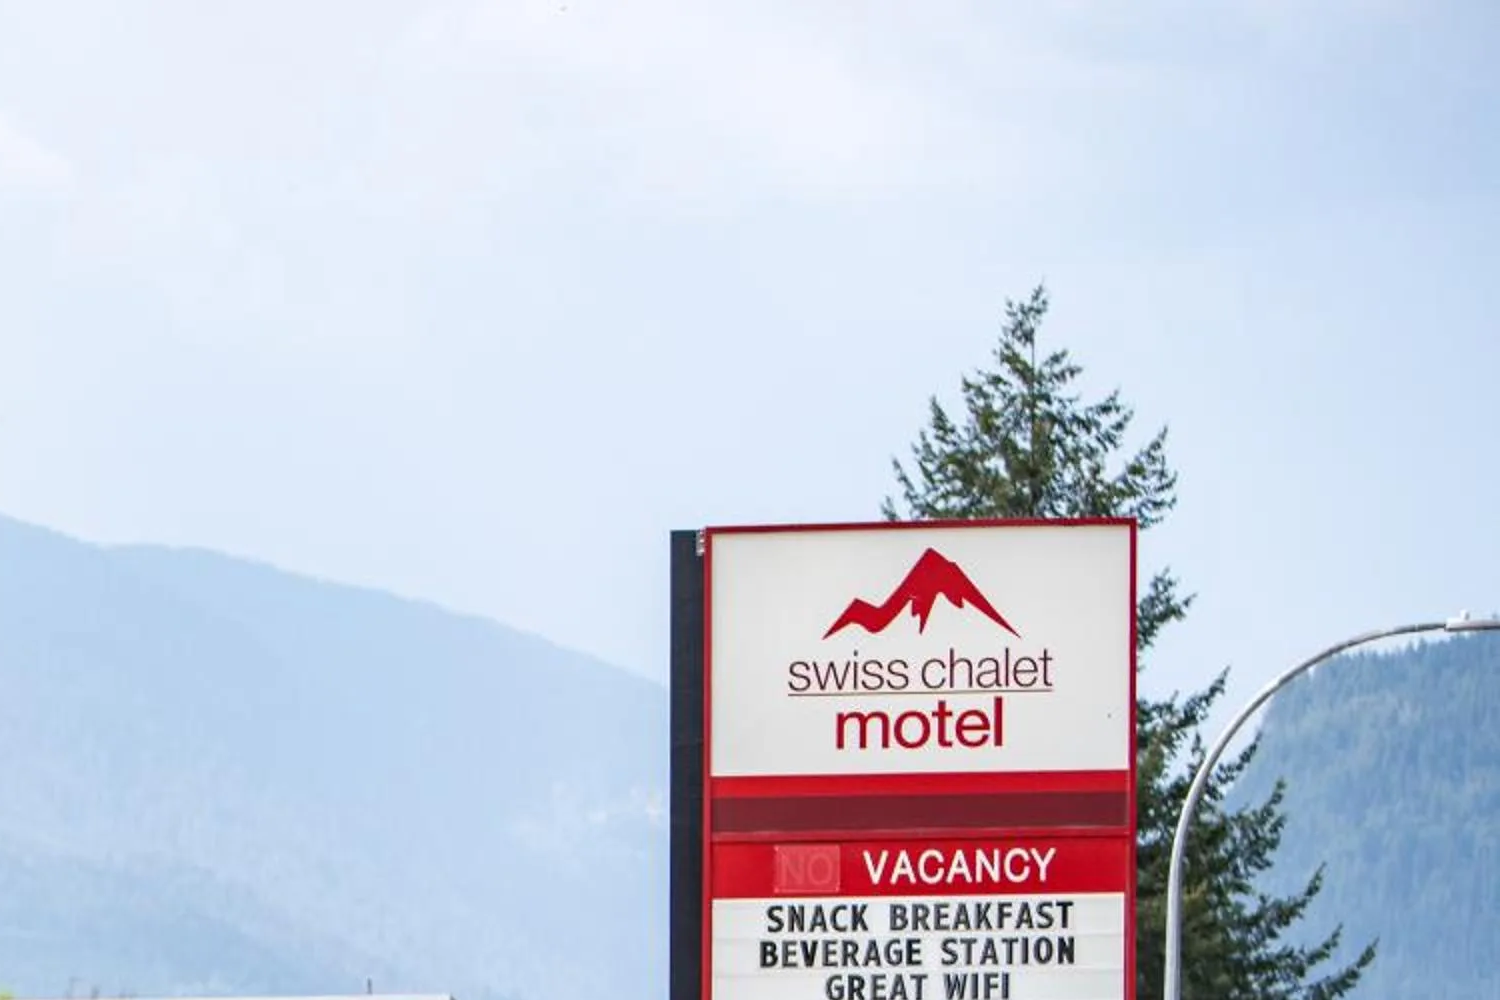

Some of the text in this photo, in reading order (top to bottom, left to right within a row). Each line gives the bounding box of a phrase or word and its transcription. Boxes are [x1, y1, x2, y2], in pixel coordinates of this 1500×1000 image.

[787, 647, 1053, 691] swiss chalet
[836, 696, 1004, 750] motel
[781, 848, 1056, 886] NO VACANCY
[767, 901, 1074, 933] SNACK BREAKFAST
[760, 936, 1075, 968] BEVERAGE STATION
[943, 972, 1010, 1000] WIFI
